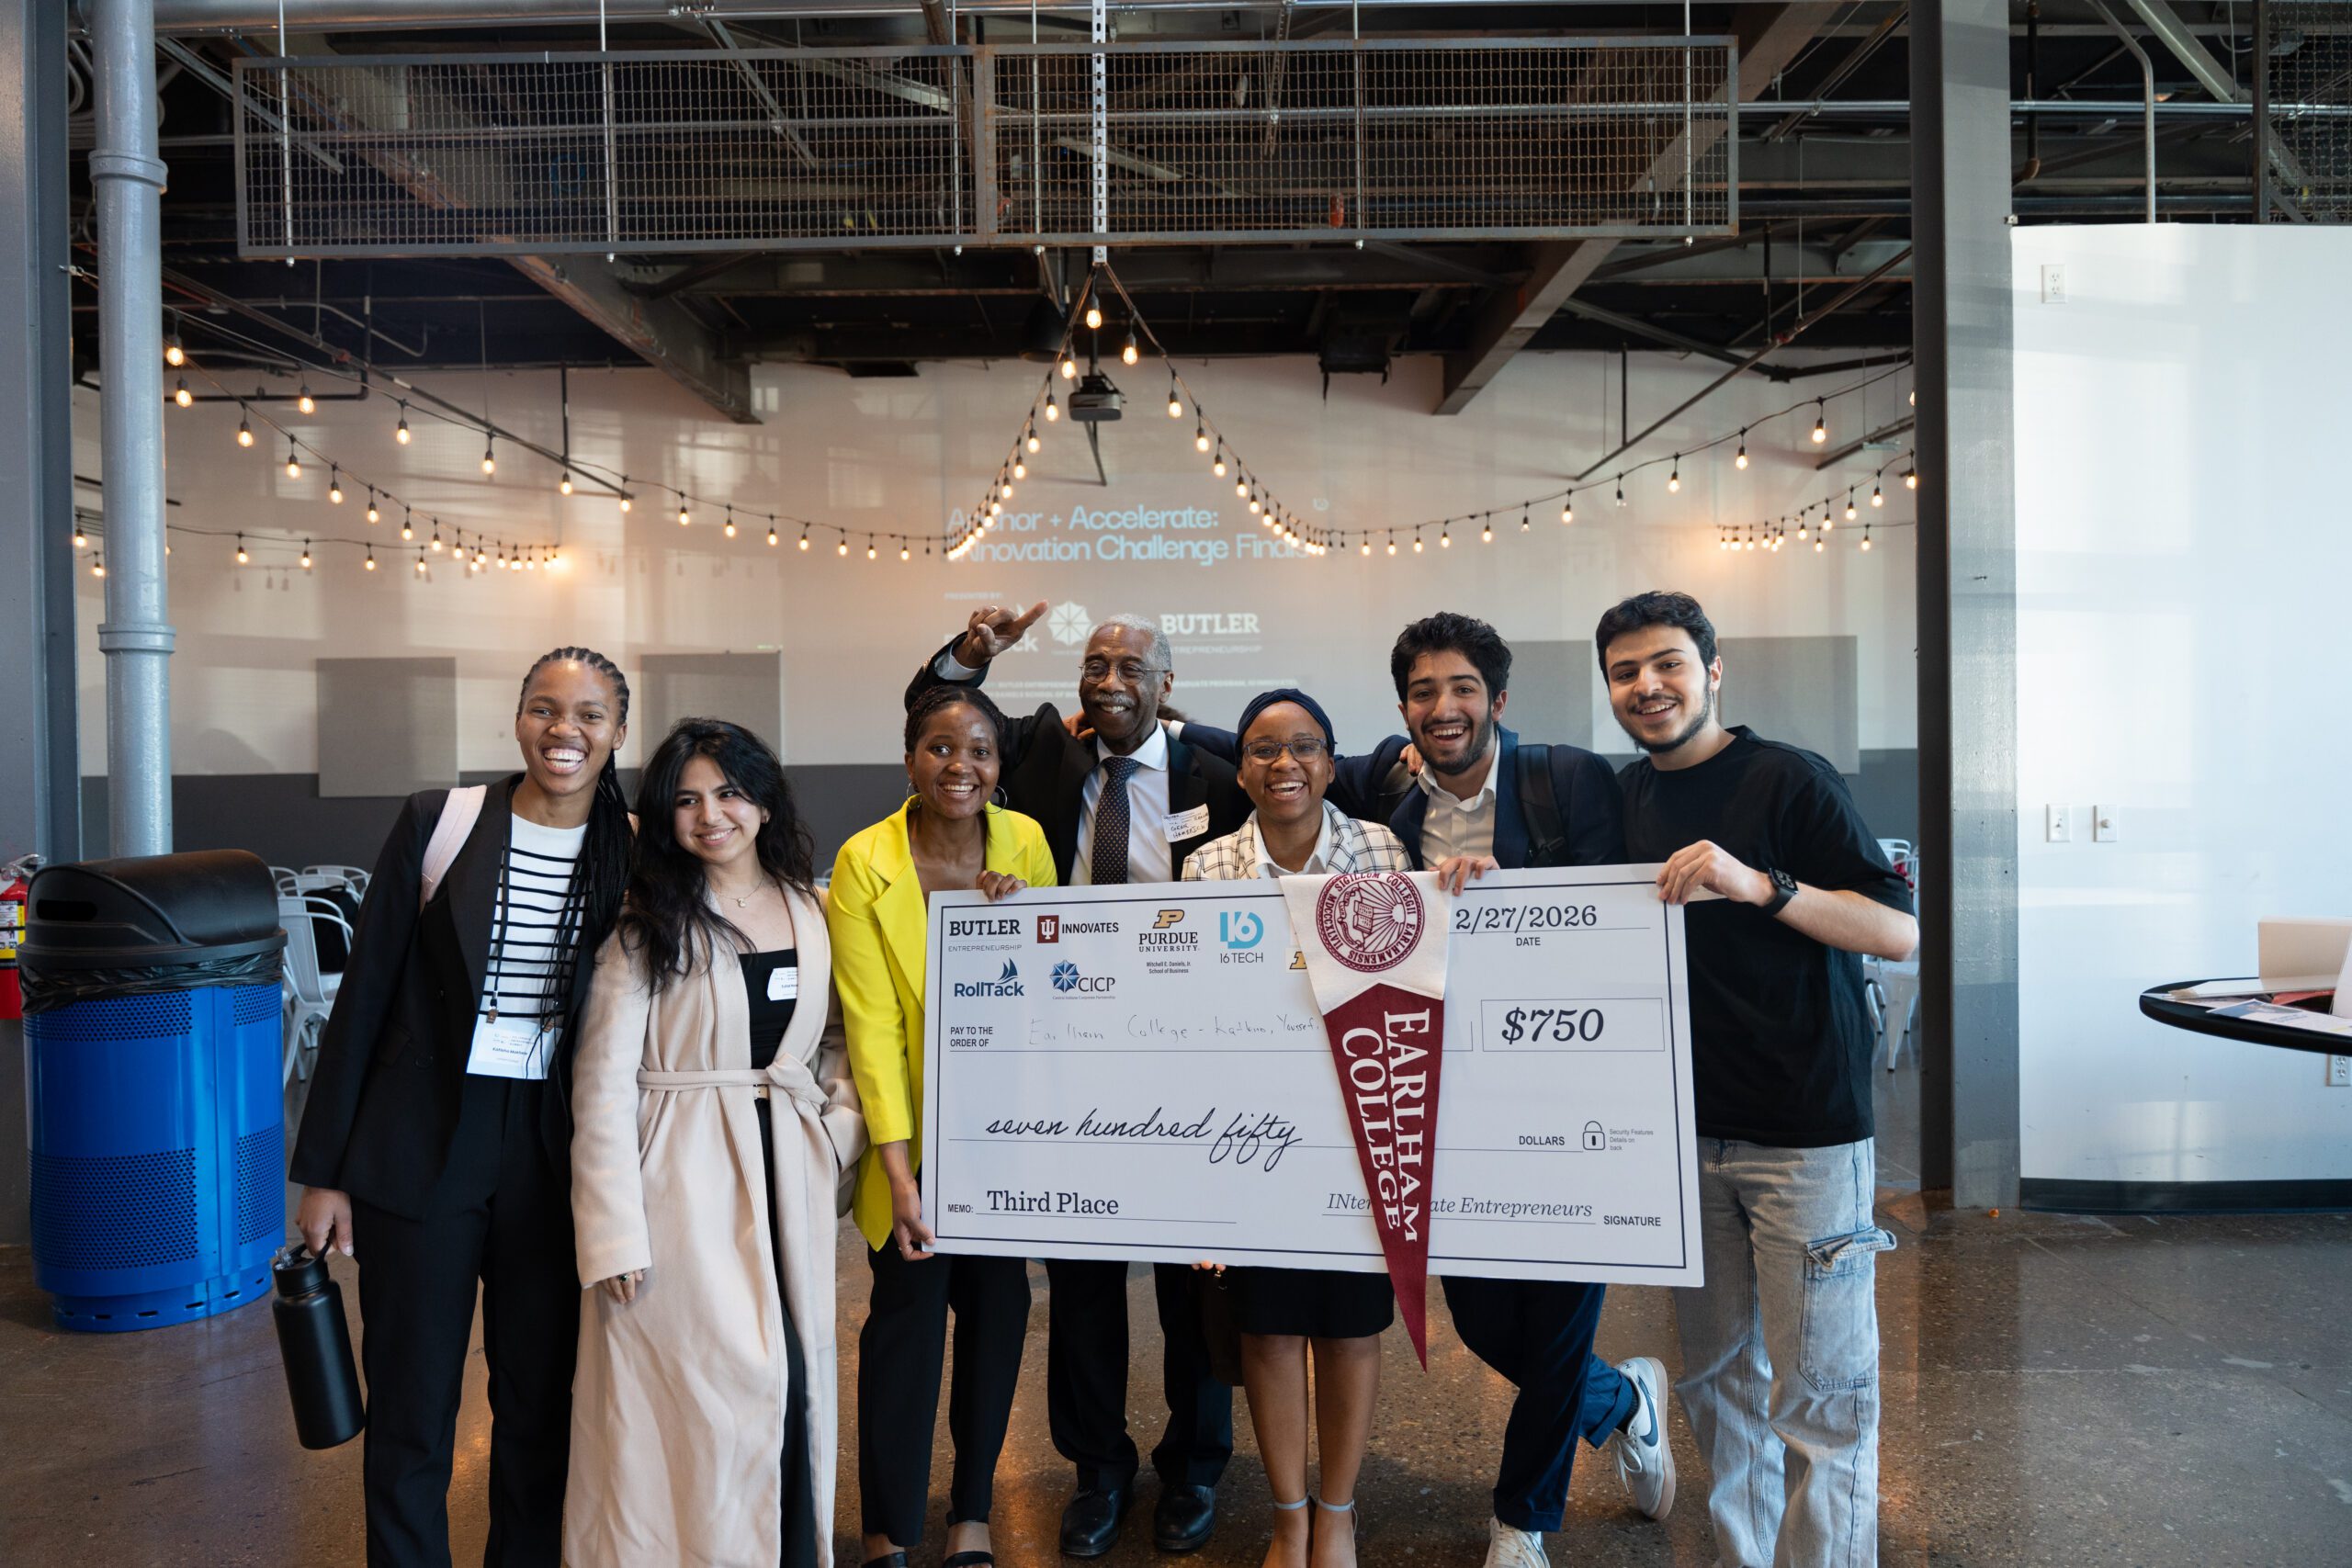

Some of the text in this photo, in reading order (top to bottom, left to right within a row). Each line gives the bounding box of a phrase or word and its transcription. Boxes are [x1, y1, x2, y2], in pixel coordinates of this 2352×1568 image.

[1069, 505, 1218, 530] Accelerate:
[1096, 534, 1228, 566] Challenge
[1160, 613, 1260, 635] BUTLER
[1335, 874, 1380, 892] SIGILLUM
[1386, 874, 1416, 915] COLLEGII
[949, 919, 1021, 936] BUTLER
[1062, 922, 1119, 934] INNOVATES
[1324, 894, 1343, 950] MDCCCXLVII
[1455, 906, 1597, 934] 2/27/2026
[1138, 931, 1198, 945] PURDUE
[1348, 923, 1416, 964] EARLHAMENSIS
[1516, 937, 1541, 946] DATE
[1220, 952, 1263, 964] 16 TECH
[955, 982, 1024, 997] RollTack
[1078, 977, 1115, 992] CICP
[950, 1027, 993, 1035] PAY TO THE
[1127, 1014, 1188, 1042] College
[1501, 1007, 1604, 1044] $750
[950, 1039, 989, 1047] ORDER OF
[1341, 1027, 1401, 1231] COLLEGE
[1384, 1008, 1430, 1243] EARLHAM
[986, 1107, 1304, 1173] seven hundred fifty
[1519, 1135, 1566, 1145] DOLLARS
[947, 1204, 974, 1213] MEMO:
[987, 1190, 1119, 1215] Third Place
[1459, 1197, 1592, 1217] Entrepreneurs
[1603, 1215, 1661, 1226] SIGNATURE
